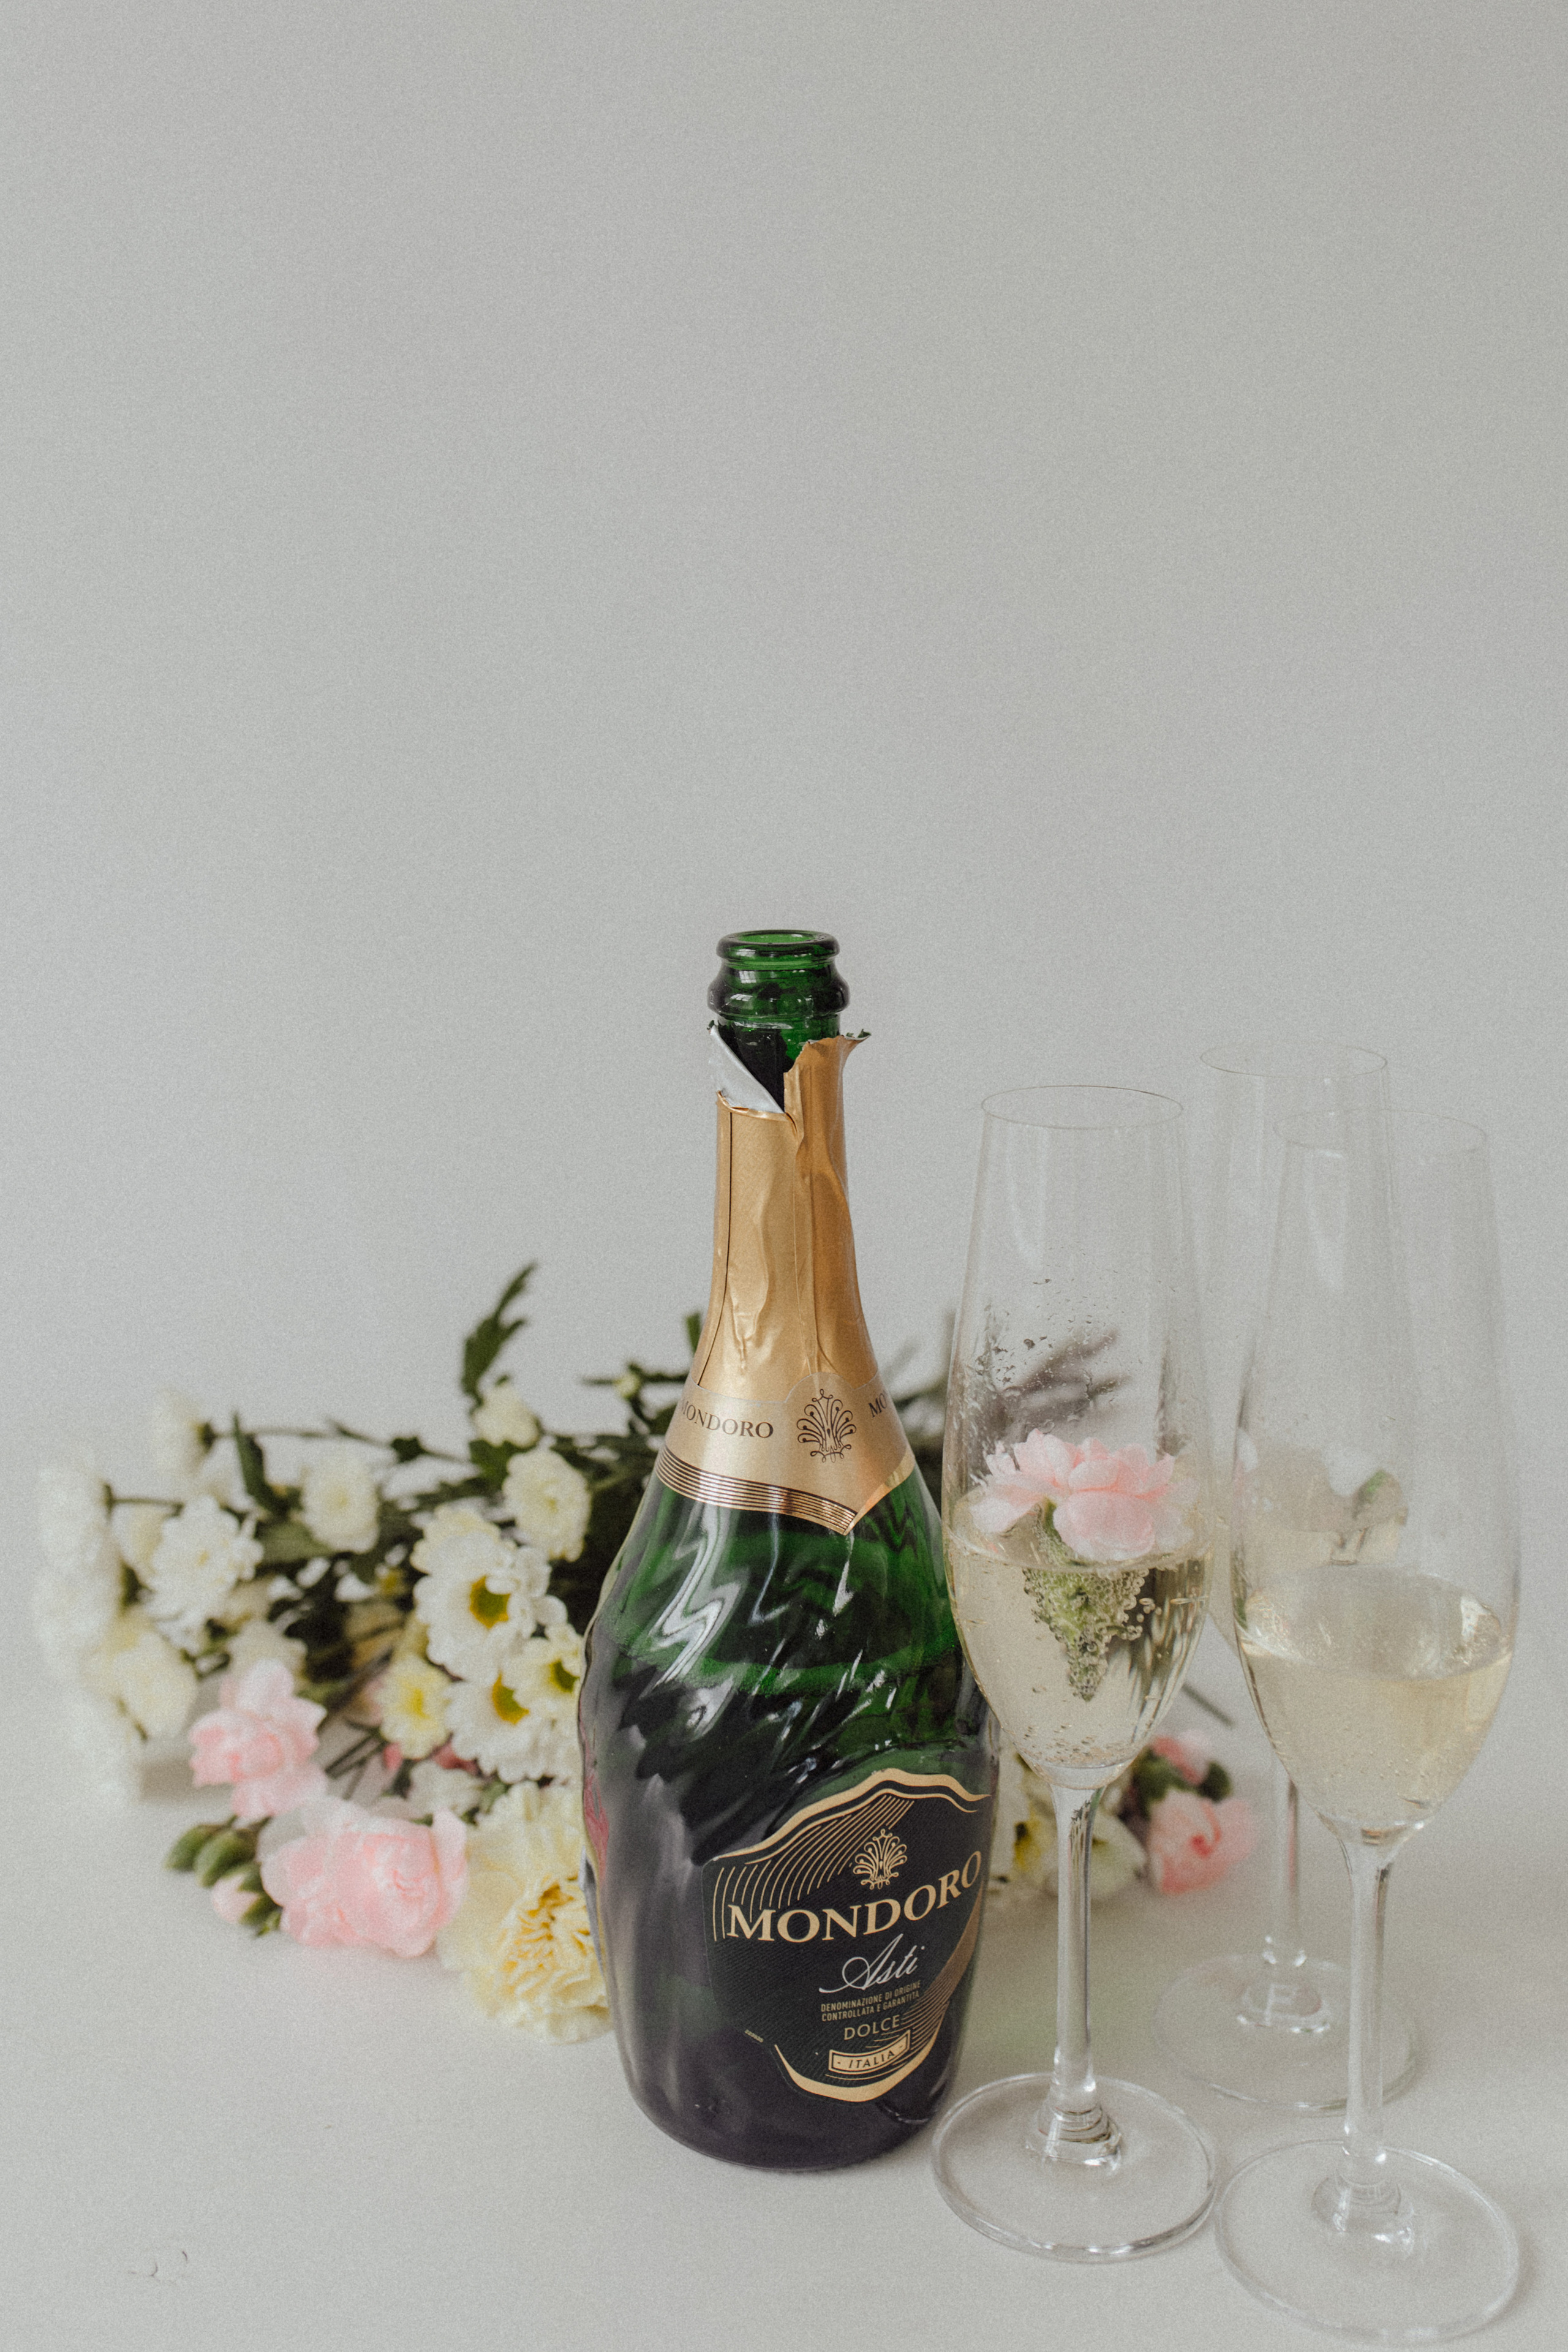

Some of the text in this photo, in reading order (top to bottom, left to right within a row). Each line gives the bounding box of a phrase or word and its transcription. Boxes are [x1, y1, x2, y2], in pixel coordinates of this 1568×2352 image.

[869, 1391, 888, 1418] MO
[727, 1850, 981, 1942] MONDORO
[819, 1933, 925, 1993] Asti
[821, 1980, 921, 2012] DENOMINAZIONE DI ORIGINE
[822, 2006, 875, 2021] CONTROLLATA
[877, 2003, 881, 2012] E
[844, 2015, 900, 2040] DOLCE
[849, 2050, 895, 2068] ITALIA
